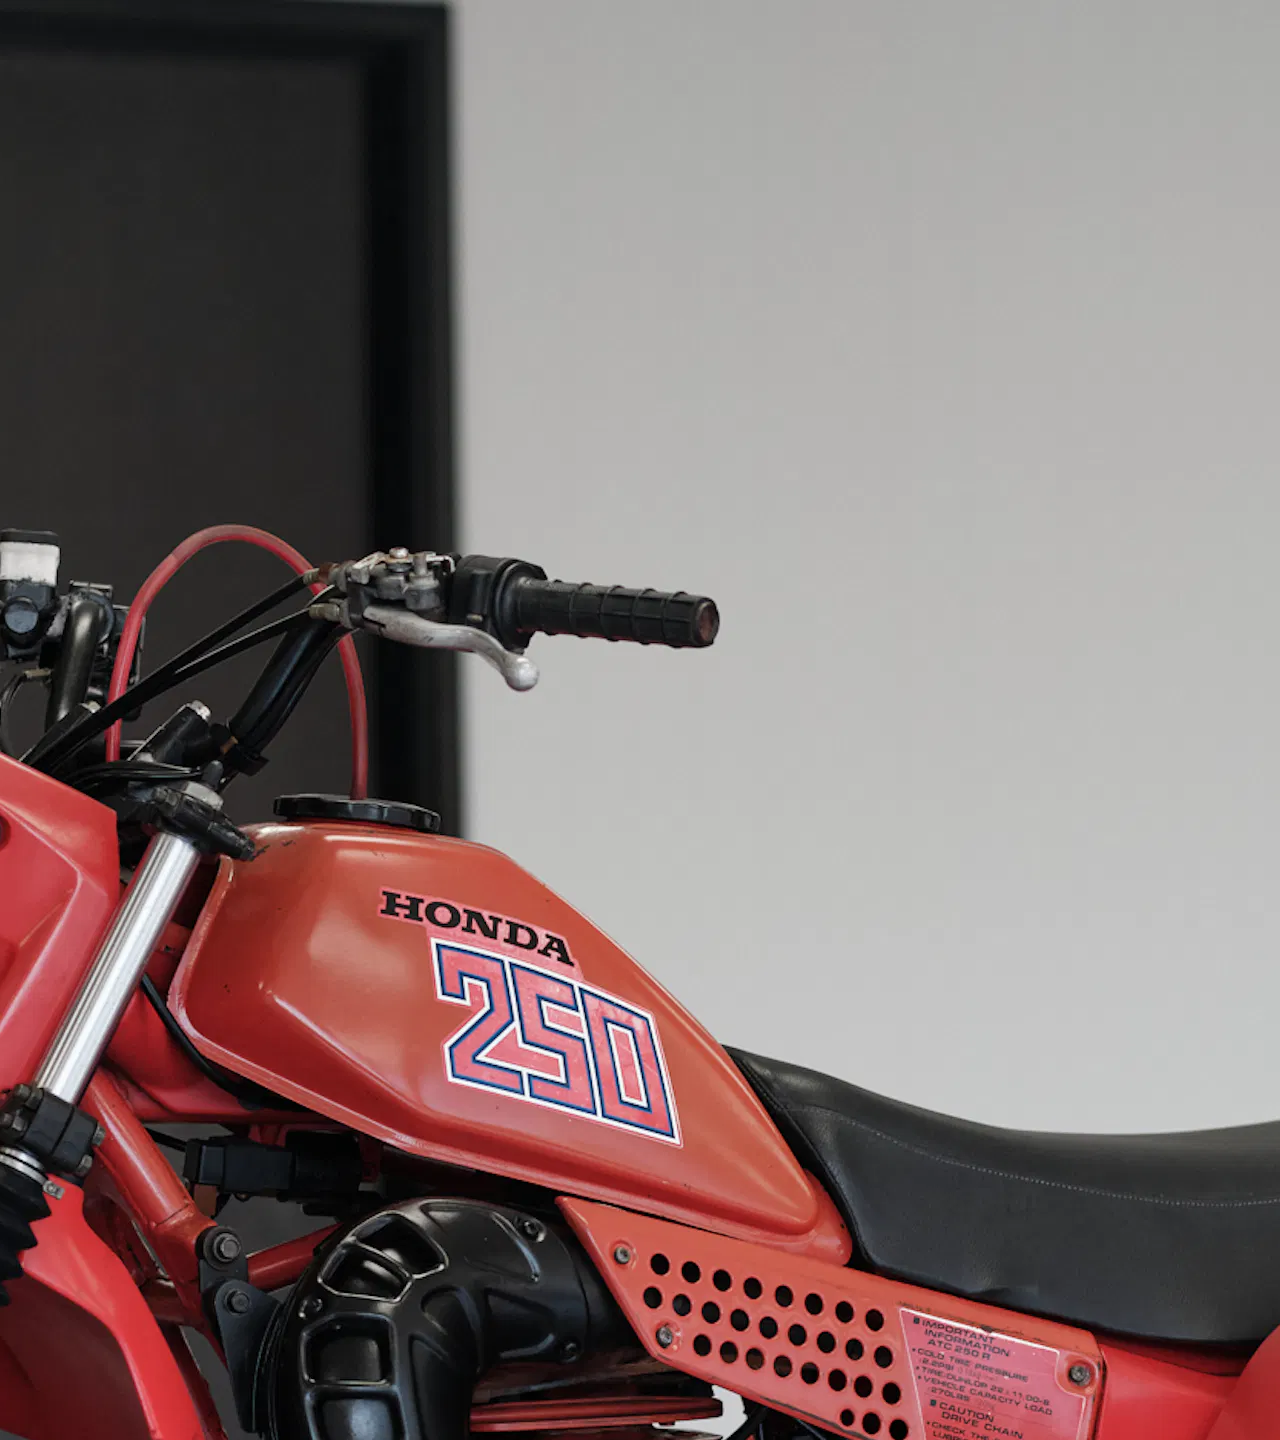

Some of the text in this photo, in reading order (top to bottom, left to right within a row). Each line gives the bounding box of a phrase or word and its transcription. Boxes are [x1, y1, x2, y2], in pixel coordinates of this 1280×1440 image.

[380, 890, 575, 967] HONDA
[431, 937, 683, 1148] 250
[922, 1320, 995, 1344] IMPORTANT
[924, 1328, 1010, 1357] INFORMATION
[927, 1339, 992, 1361] ATC 250 R
[917, 1348, 945, 1361] COLD
[949, 1356, 971, 1367] TIRE
[975, 1363, 1029, 1383] PRESSURE
[923, 1375, 965, 1393] VEHICLE
[970, 1386, 1021, 1407] CAPACITY
[1024, 1403, 1054, 1417] LOAD
[939, 1401, 995, 1423] CAUTION
[941, 1411, 1024, 1440] DRIVE CHAIN
[931, 1421, 966, 1436] CHECK
